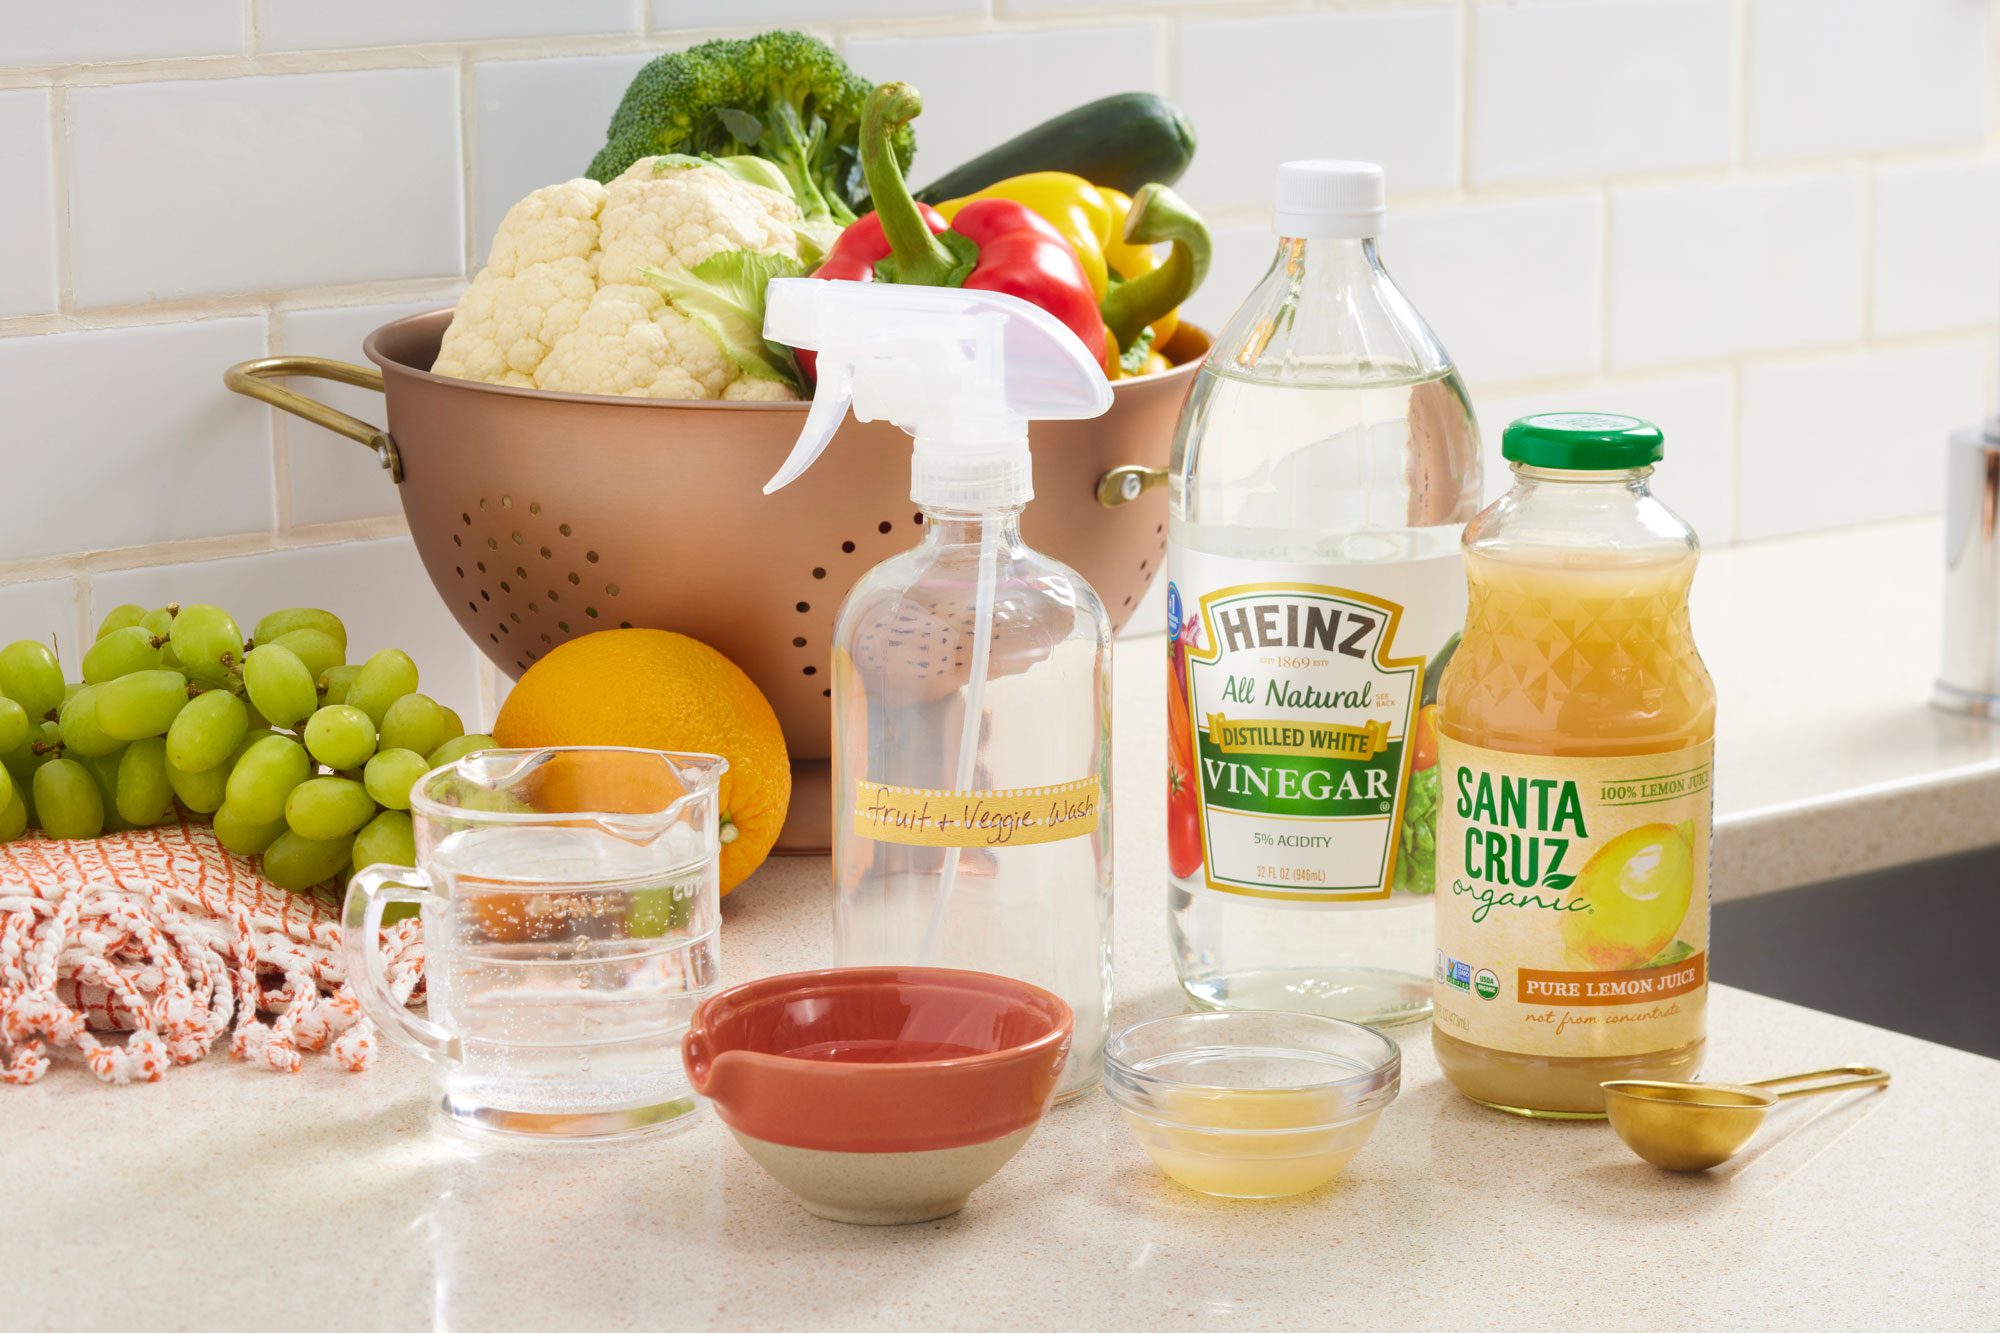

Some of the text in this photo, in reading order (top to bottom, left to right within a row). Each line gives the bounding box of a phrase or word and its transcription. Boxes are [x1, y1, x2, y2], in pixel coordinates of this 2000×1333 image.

[1219, 604, 1376, 660] HEINZ
[1276, 655, 1311, 669] 1869
[1222, 674, 1373, 709] All Natural
[1376, 700, 1396, 708] BACK
[1222, 727, 1370, 753] DISTILLED WHITE
[1203, 757, 1392, 801] VINEGAR
[1600, 786, 1637, 800] 100%
[1641, 778, 1685, 798] LEMON
[868, 787, 1094, 844] fruit + Veggie Wash
[1457, 766, 1589, 838] SANTA
[1254, 832, 1332, 848] 5% ACIDITY
[1465, 826, 1577, 890] CRUZ
[1256, 865, 1326, 883] 32 FL OZ (946mL)
[1452, 879, 1592, 923] organic
[1478, 984, 1497, 993] ORGANIC
[1480, 975, 1494, 985] USDA
[1526, 968, 1696, 997] PURE LEMON JUICE
[1525, 1003, 1681, 1035] not from concentrate
